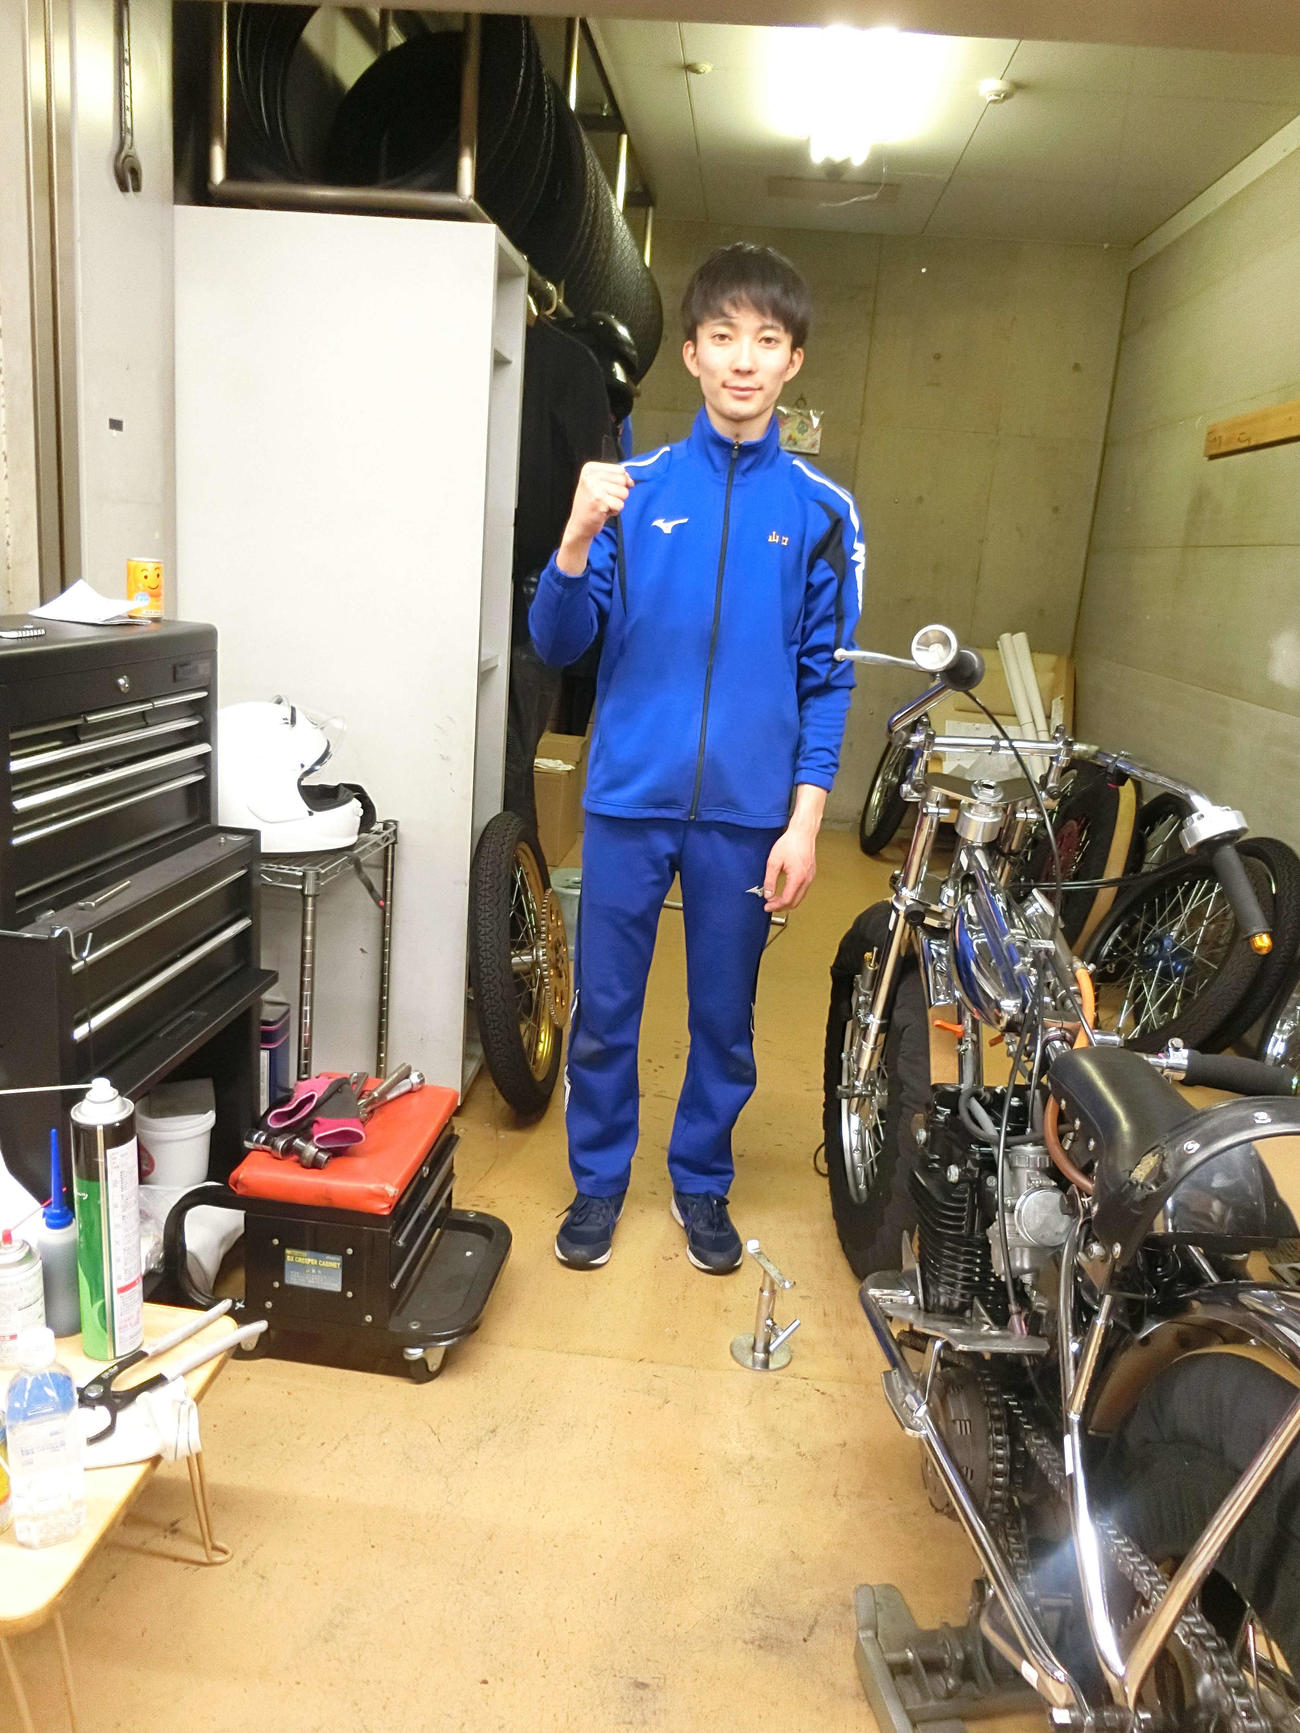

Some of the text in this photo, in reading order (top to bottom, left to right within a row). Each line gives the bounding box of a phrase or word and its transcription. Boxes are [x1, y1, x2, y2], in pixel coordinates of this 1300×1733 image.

[768, 531, 789, 545] 山口
[295, 1256, 318, 1266] CREEPER
[319, 1260, 340, 1268] CABINET
